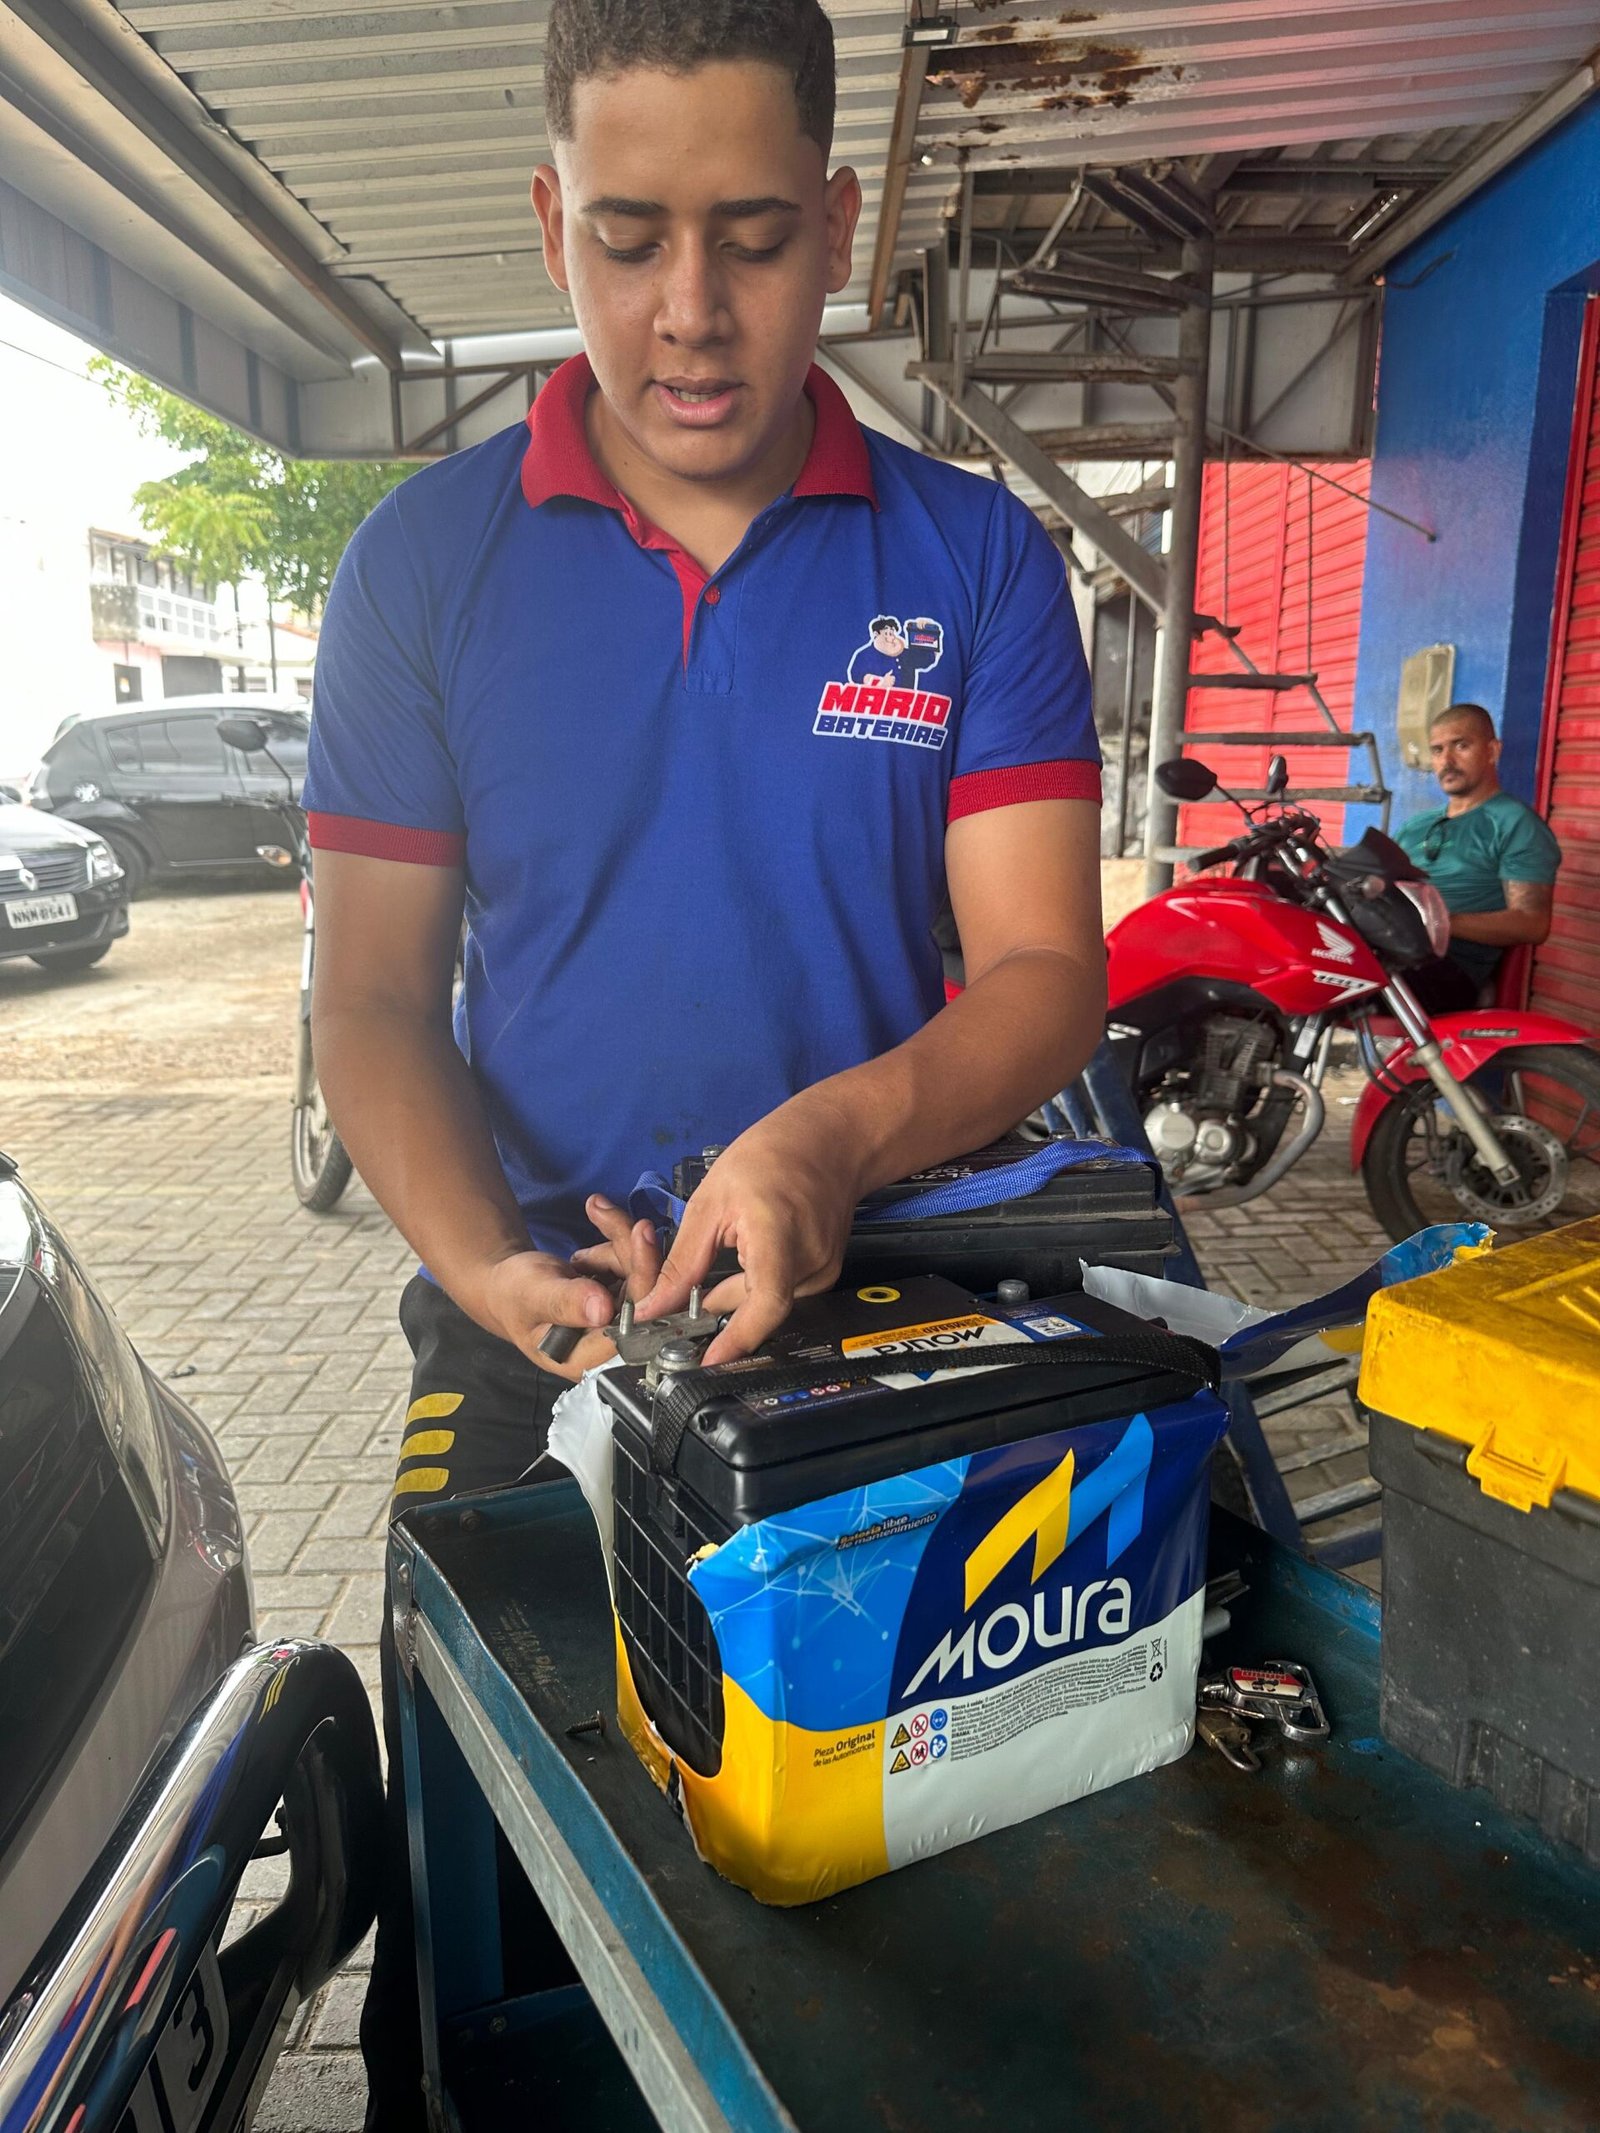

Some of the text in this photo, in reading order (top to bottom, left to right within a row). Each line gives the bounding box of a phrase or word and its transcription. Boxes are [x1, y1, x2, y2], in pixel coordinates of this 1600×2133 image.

[820, 679, 951, 725] MÁRIO
[816, 714, 947, 748] BATERIAS
[882, 1515, 908, 1530] libre
[813, 1742, 875, 1767] de las Automotrices
[814, 1729, 876, 1758] Pieza Original
